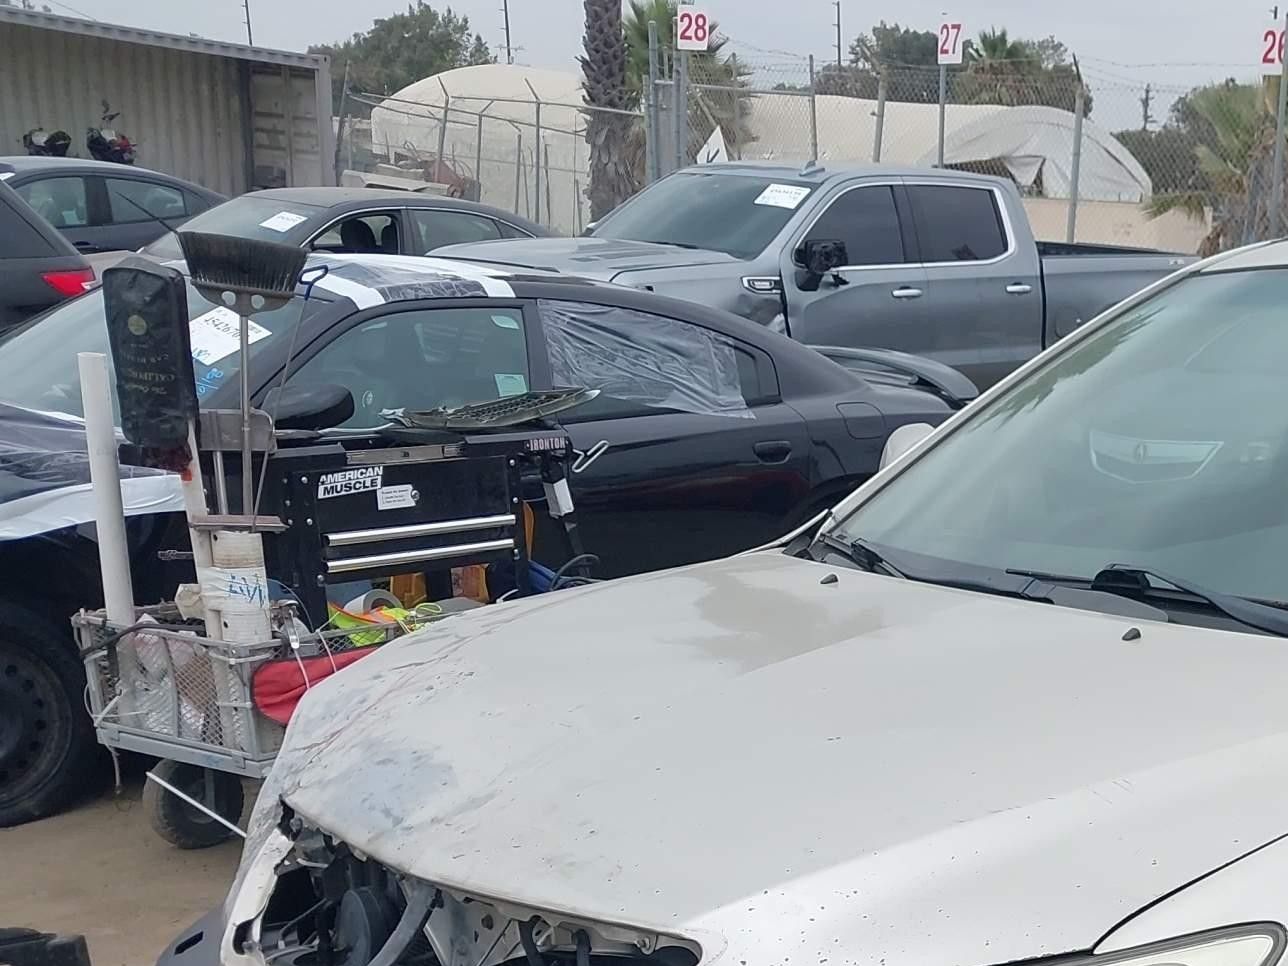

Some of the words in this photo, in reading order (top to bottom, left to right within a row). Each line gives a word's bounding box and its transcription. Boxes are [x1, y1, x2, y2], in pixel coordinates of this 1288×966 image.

[680, 13, 707, 41] 28
[940, 24, 961, 54] 27
[530, 437, 566, 451] IRONTON
[319, 466, 383, 484] AMERICAN
[322, 477, 379, 497] MUSCLE
